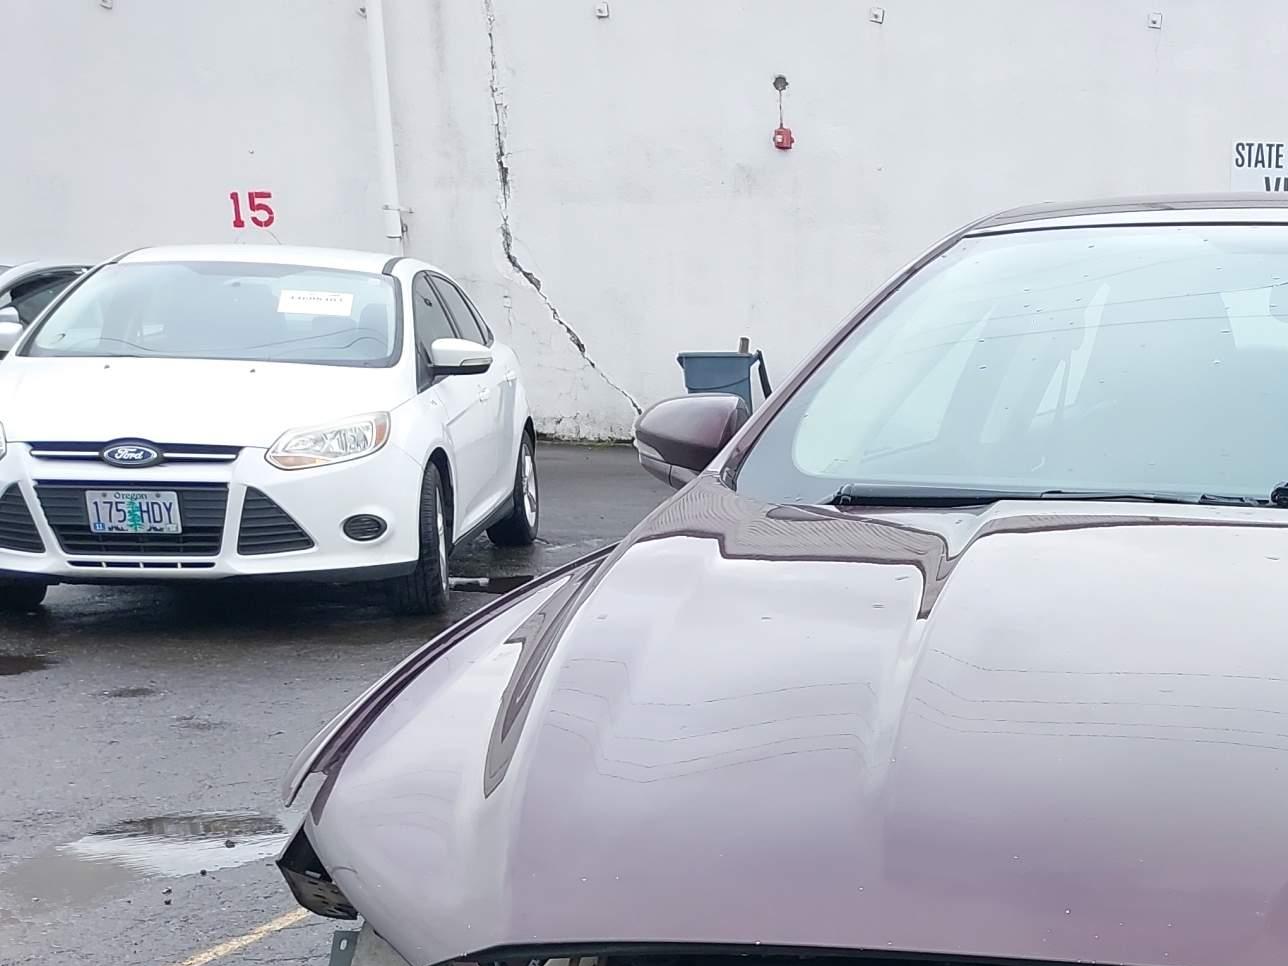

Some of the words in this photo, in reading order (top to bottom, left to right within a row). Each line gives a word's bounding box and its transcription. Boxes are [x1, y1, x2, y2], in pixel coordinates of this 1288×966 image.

[1235, 142, 1284, 169] STATE
[230, 191, 274, 228] 15
[114, 447, 144, 460] Ford
[114, 492, 148, 501] Oregon
[93, 501, 127, 523] 175
[138, 502, 173, 524] HDY
